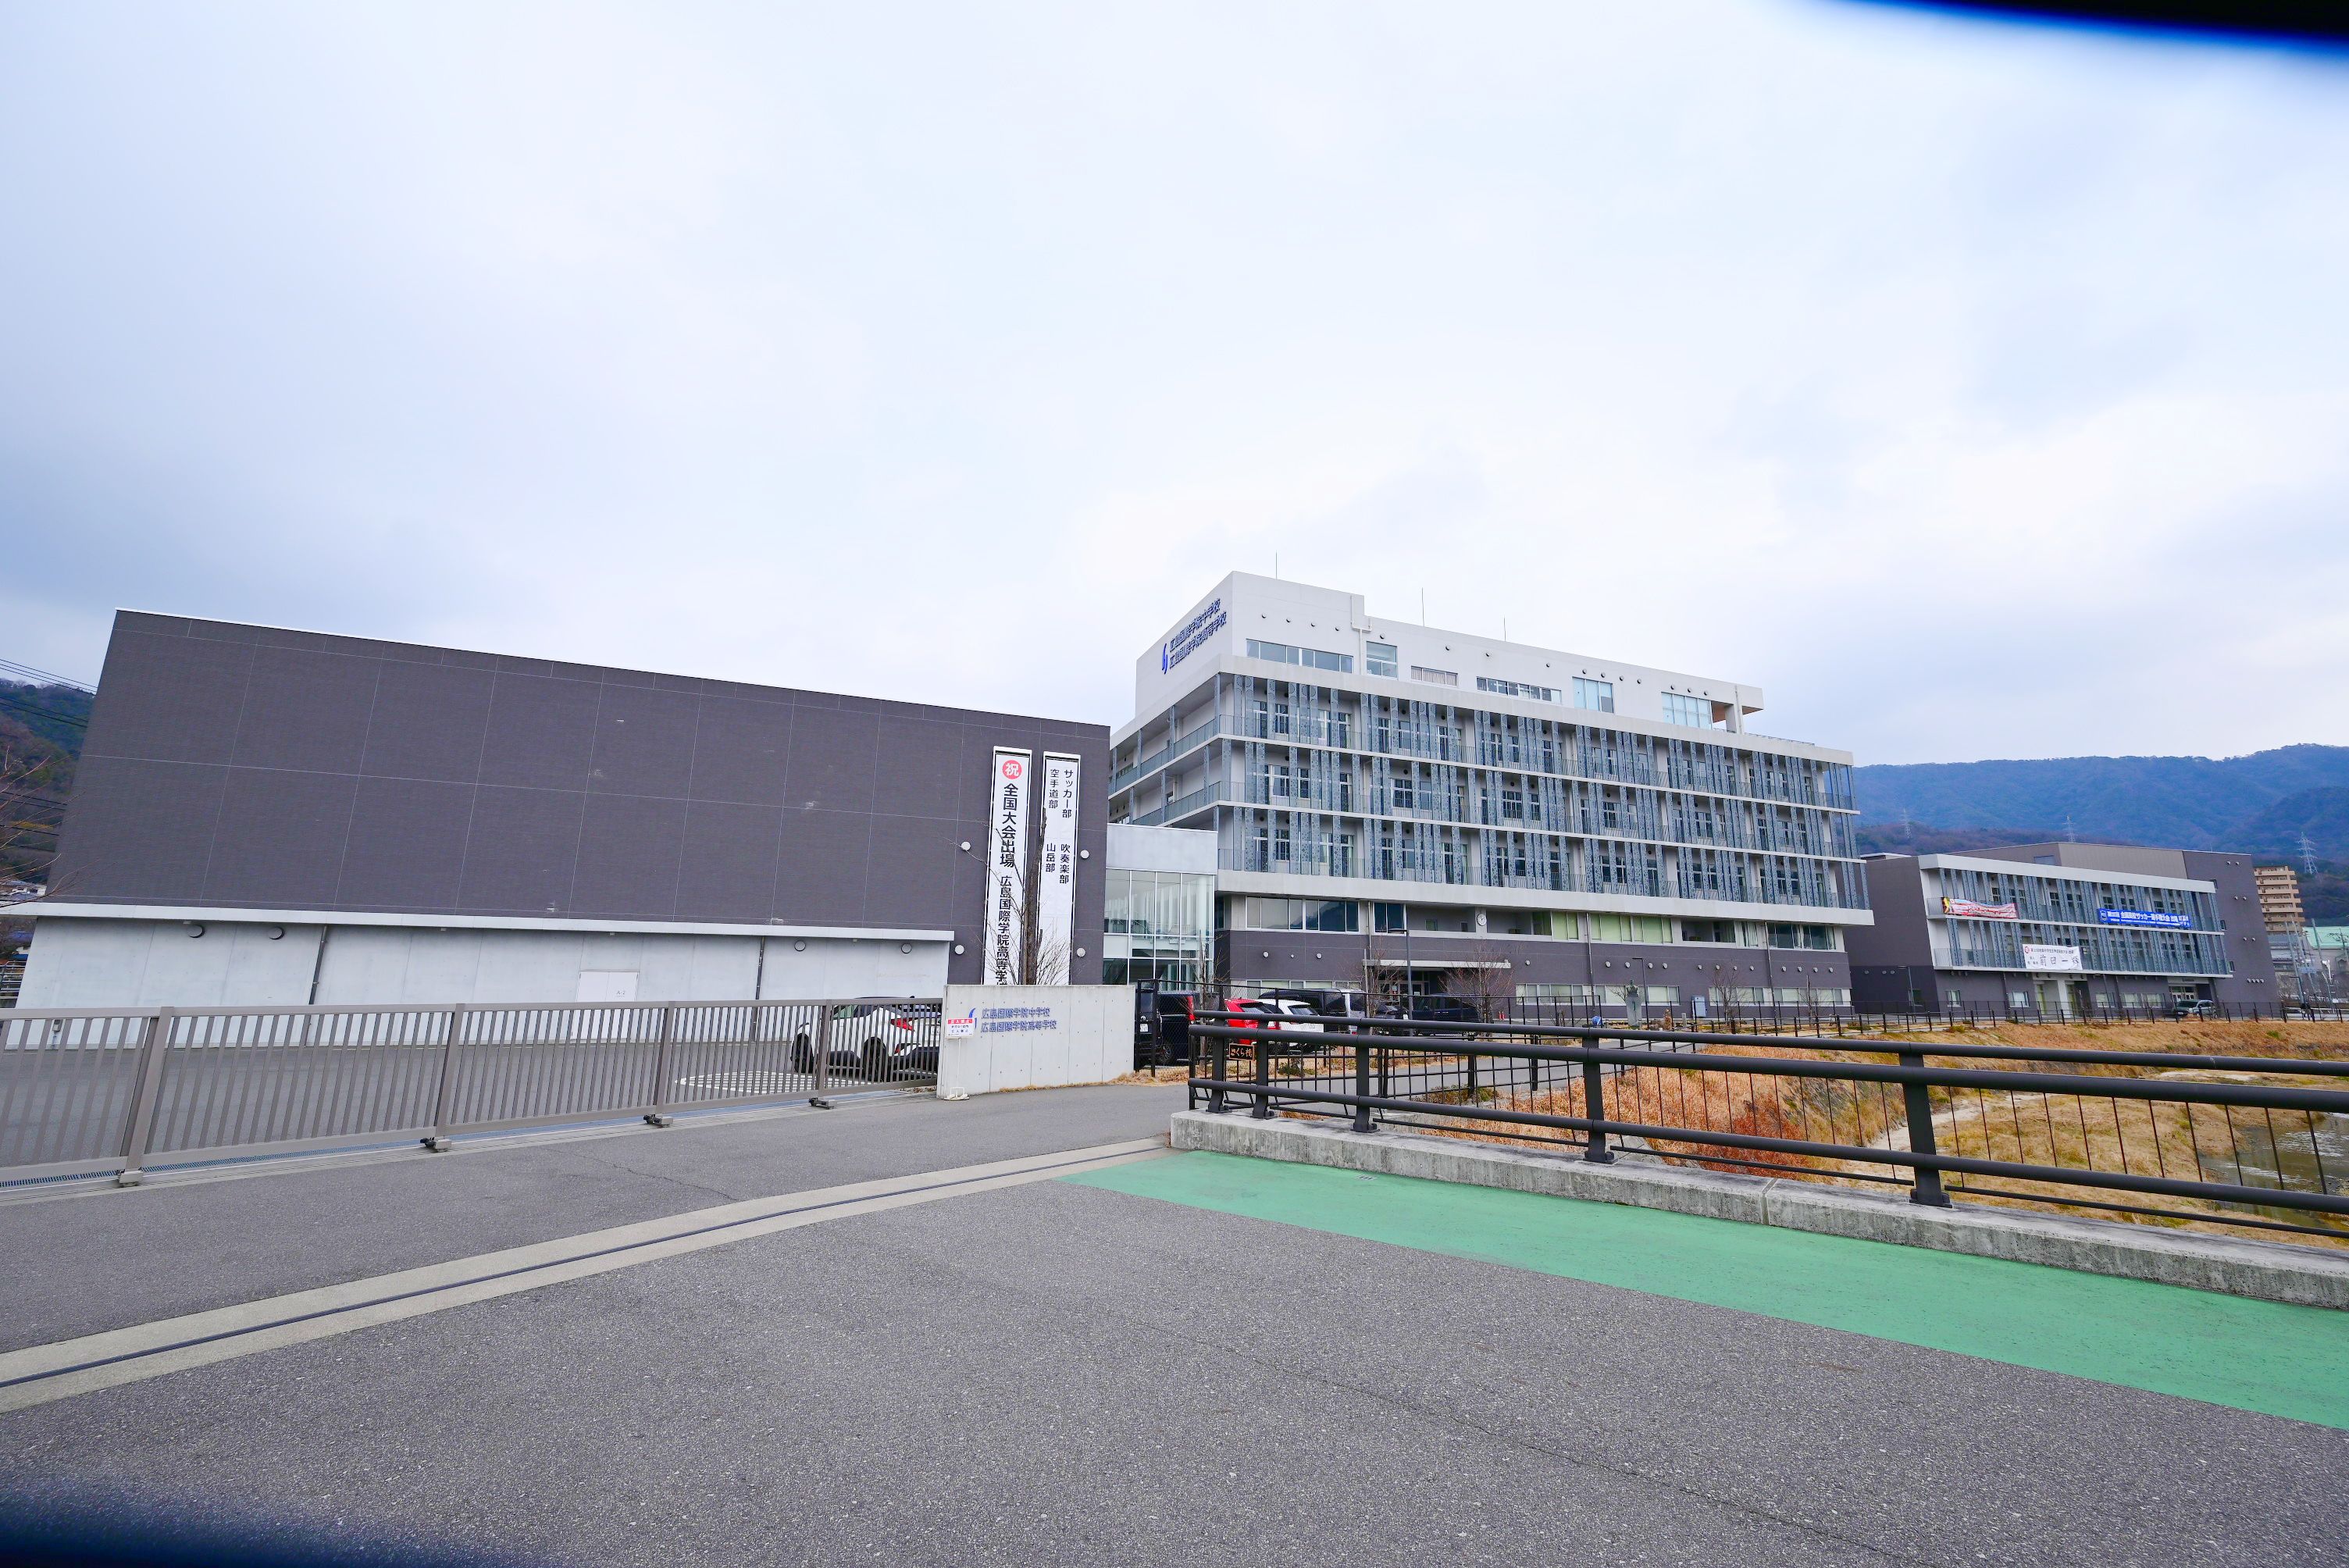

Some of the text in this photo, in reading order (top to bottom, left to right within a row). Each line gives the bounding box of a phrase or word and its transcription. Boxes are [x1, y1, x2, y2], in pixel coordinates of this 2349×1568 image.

[1045, 768, 1060, 873] 空手道部 山岳部
[1059, 769, 1074, 885] サッカー部 吹奏楽部
[995, 761, 1021, 985] 祝 全国大会出場 広島国際学院高等学
[981, 1020, 1057, 1032] 広島国際学院高等学校
[982, 1007, 1050, 1019] 広島国際学院中学校
[1230, 1047, 1253, 1058] さくら橋
